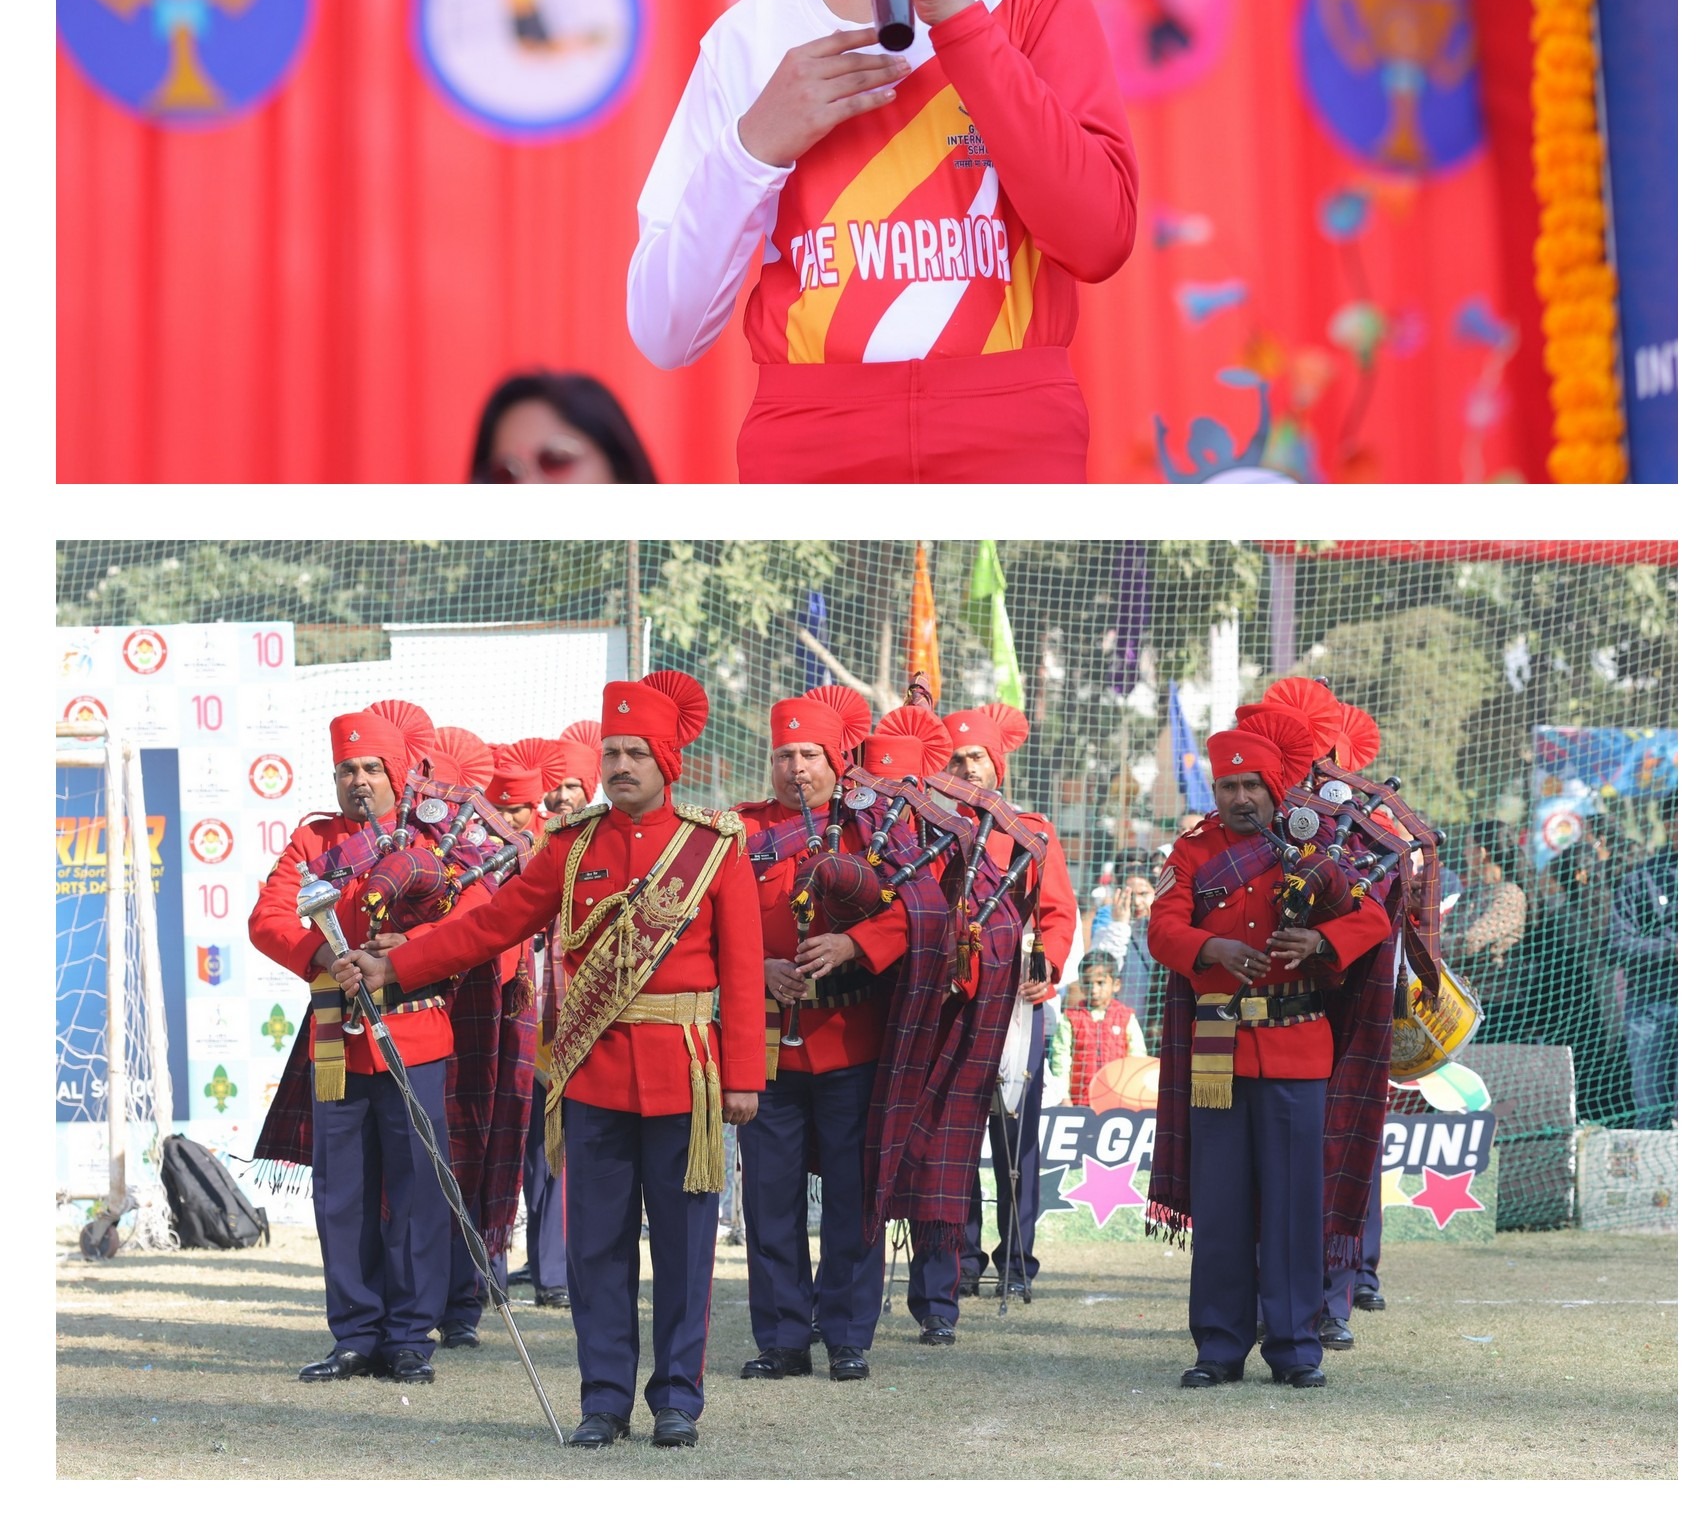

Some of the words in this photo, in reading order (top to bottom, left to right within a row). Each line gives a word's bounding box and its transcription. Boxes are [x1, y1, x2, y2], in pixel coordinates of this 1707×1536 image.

[947, 135, 984, 146] INTERN
[790, 223, 838, 292] THE
[848, 216, 1011, 283] WARRIOR
[252, 631, 283, 668] 10
[191, 694, 222, 731] 10
[256, 820, 287, 856] 10
[57, 867, 71, 878] of
[198, 884, 229, 919] 10
